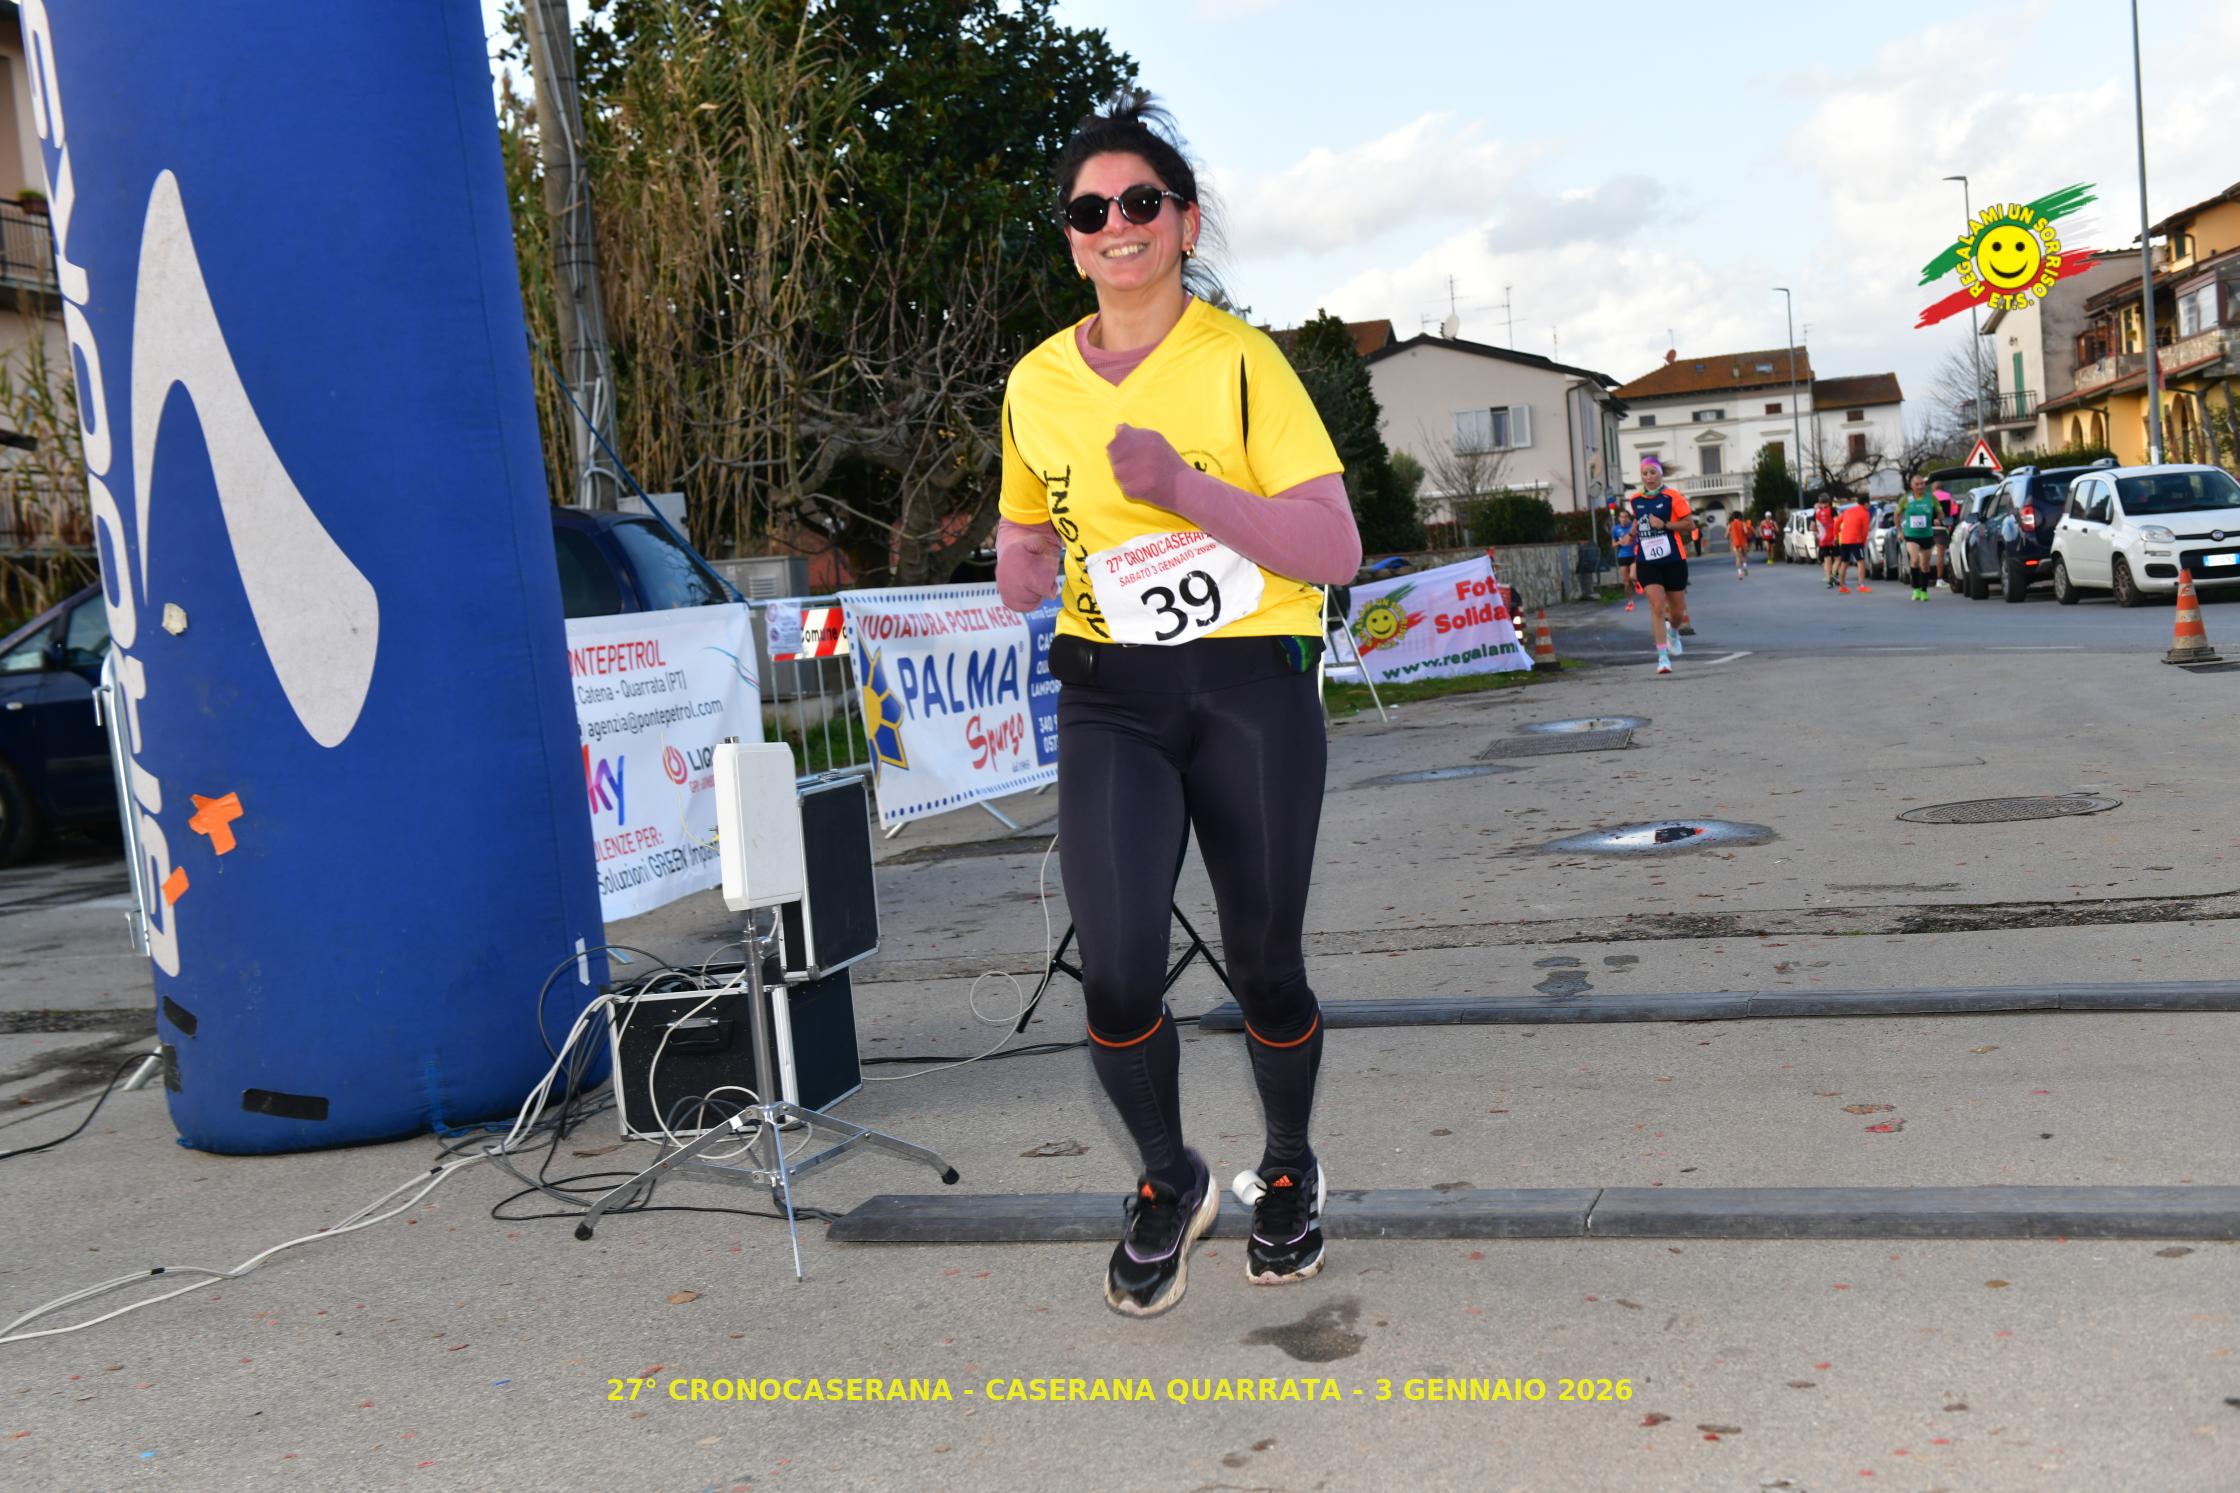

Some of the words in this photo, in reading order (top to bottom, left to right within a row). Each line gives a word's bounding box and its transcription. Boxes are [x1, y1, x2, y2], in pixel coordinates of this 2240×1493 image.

[1119, 567, 1151, 587] SABATO
[1153, 565, 1158, 575] 3
[1159, 549, 1195, 573] GENNAIO
[1196, 543, 1217, 555] 2026
[1650, 546, 1664, 557] 40
[857, 612, 947, 640] VUOTATURA
[949, 608, 989, 633] POZZI
[1141, 570, 1222, 642] 39
[577, 684, 615, 705] Catena
[620, 677, 666, 699] Quarrata
[666, 669, 688, 692] (PT)
[897, 644, 1020, 720] PALMA
[588, 699, 724, 741] agenzia@pontepetrol.com
[966, 712, 1025, 772] Spurgo
[635, 826, 665, 851] PER:
